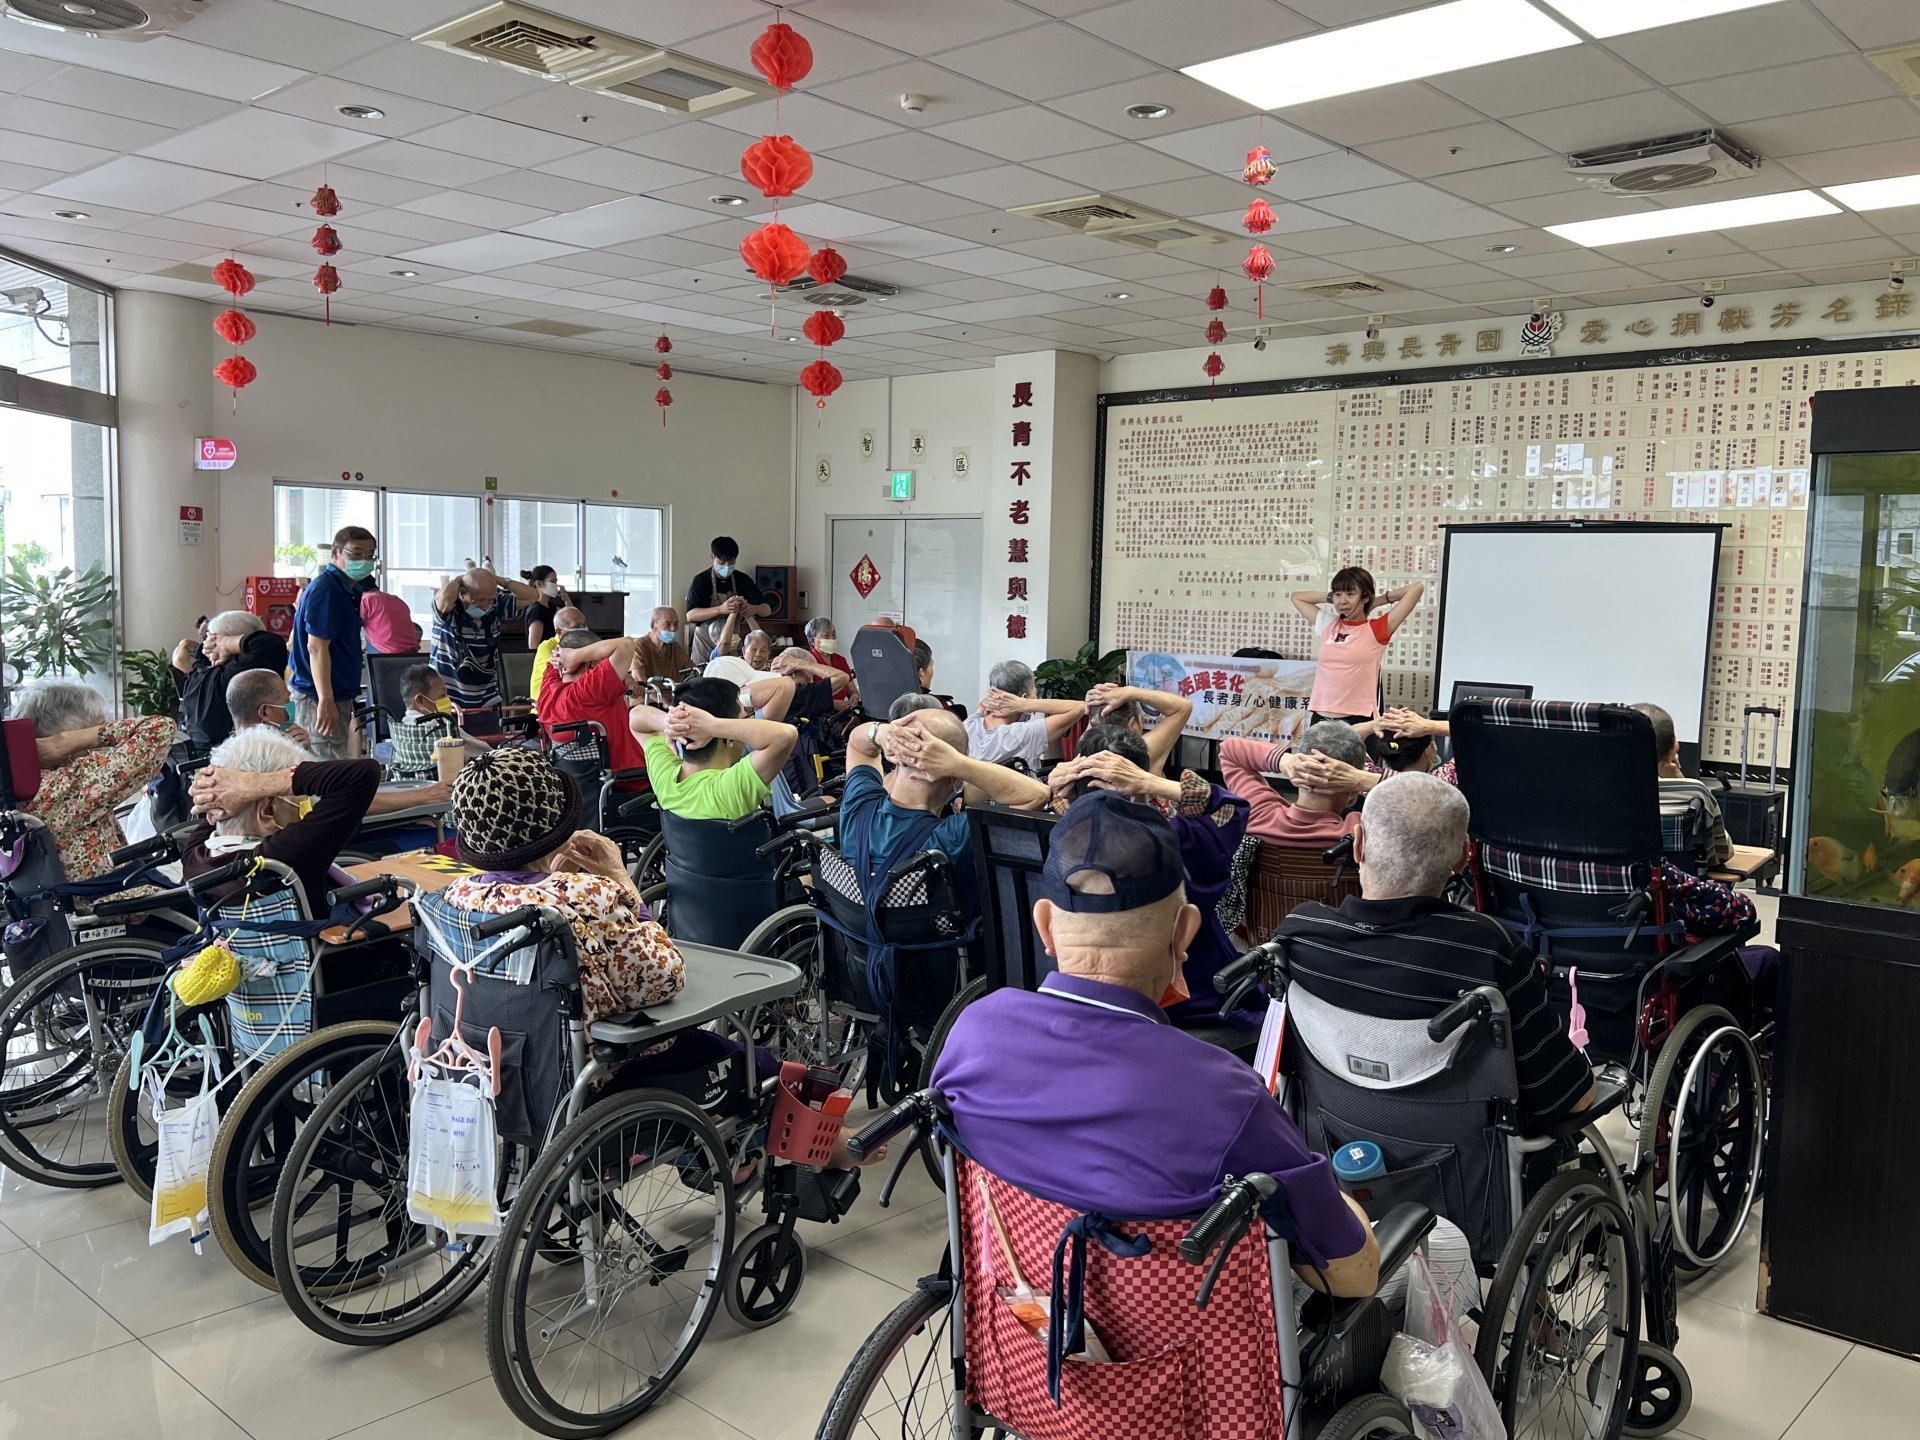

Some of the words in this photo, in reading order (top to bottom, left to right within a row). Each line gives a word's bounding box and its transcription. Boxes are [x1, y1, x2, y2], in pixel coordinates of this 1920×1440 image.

[1580, 293, 1912, 344] 愛心捐獻芳名錄
[1326, 329, 1500, 366] 濟興長青園
[1006, 382, 1033, 639] 長青不老慧與德
[1178, 671, 1246, 697] 活躍老化
